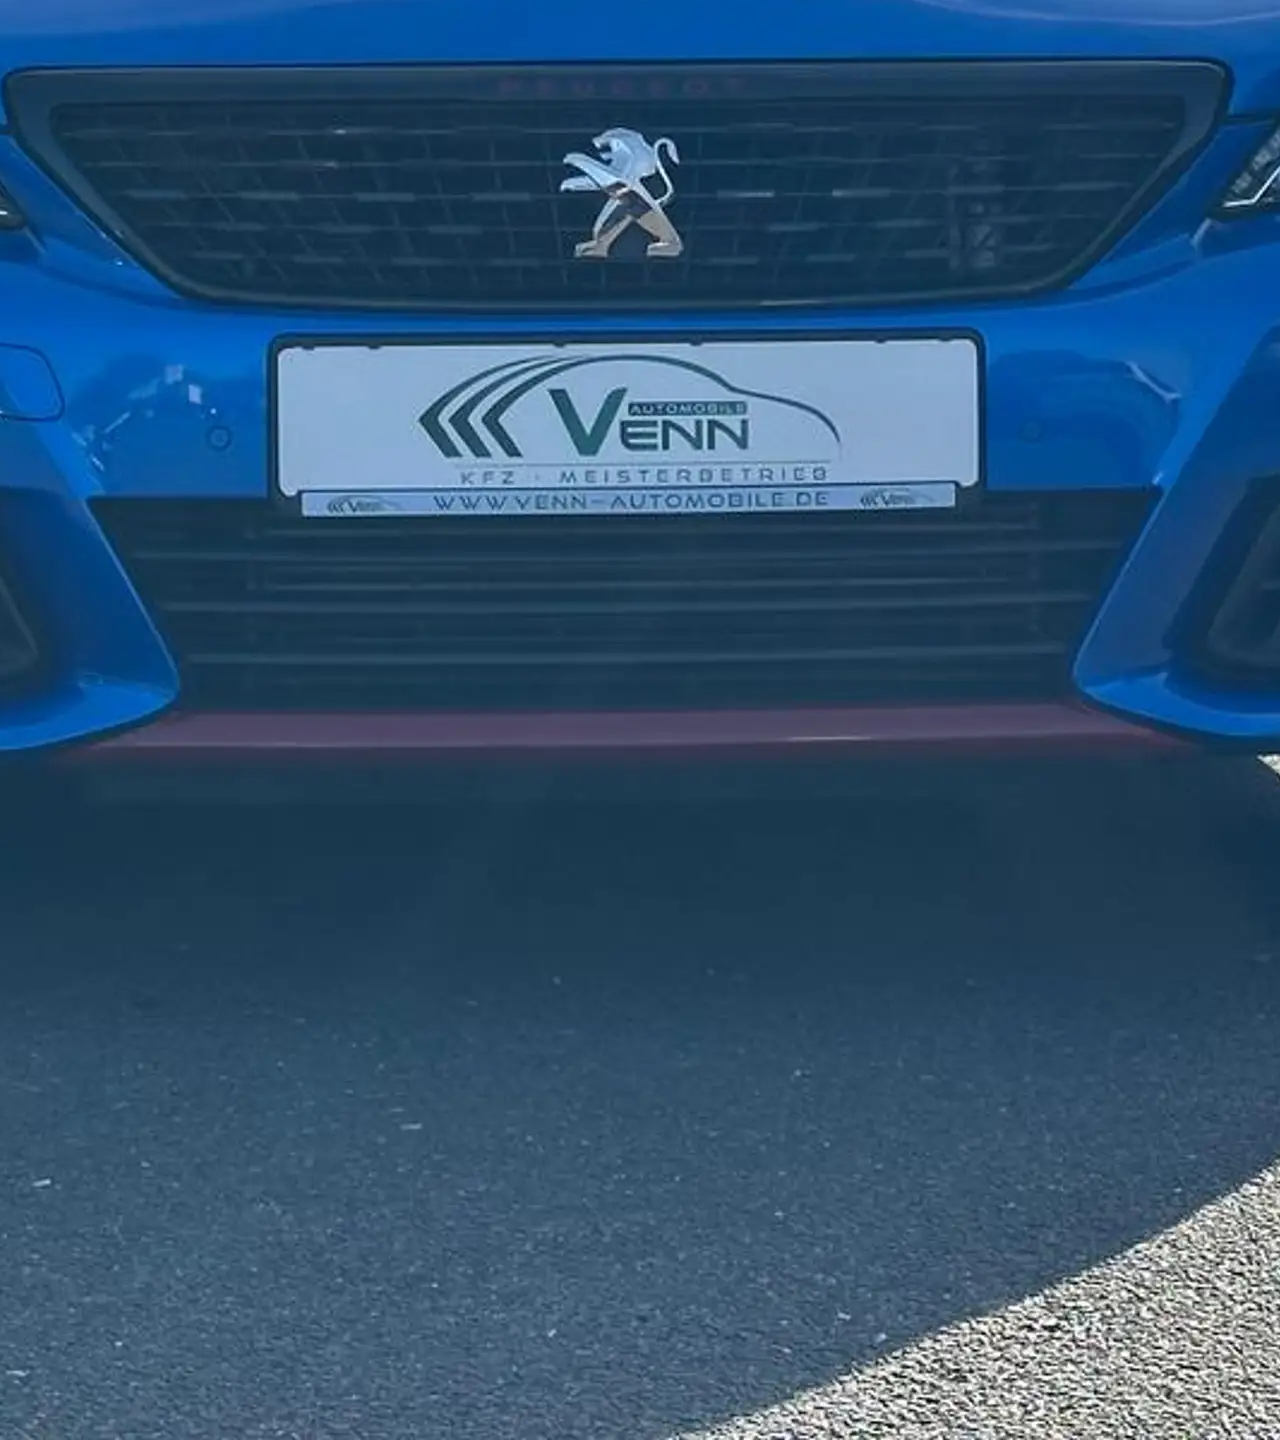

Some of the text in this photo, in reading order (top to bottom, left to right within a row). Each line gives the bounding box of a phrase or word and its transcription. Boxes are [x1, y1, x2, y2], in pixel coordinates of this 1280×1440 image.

[631, 402, 746, 415] AUTOMOBILE
[549, 387, 749, 457] VENN
[460, 467, 827, 485] KFZ MEISTERBETRIEB
